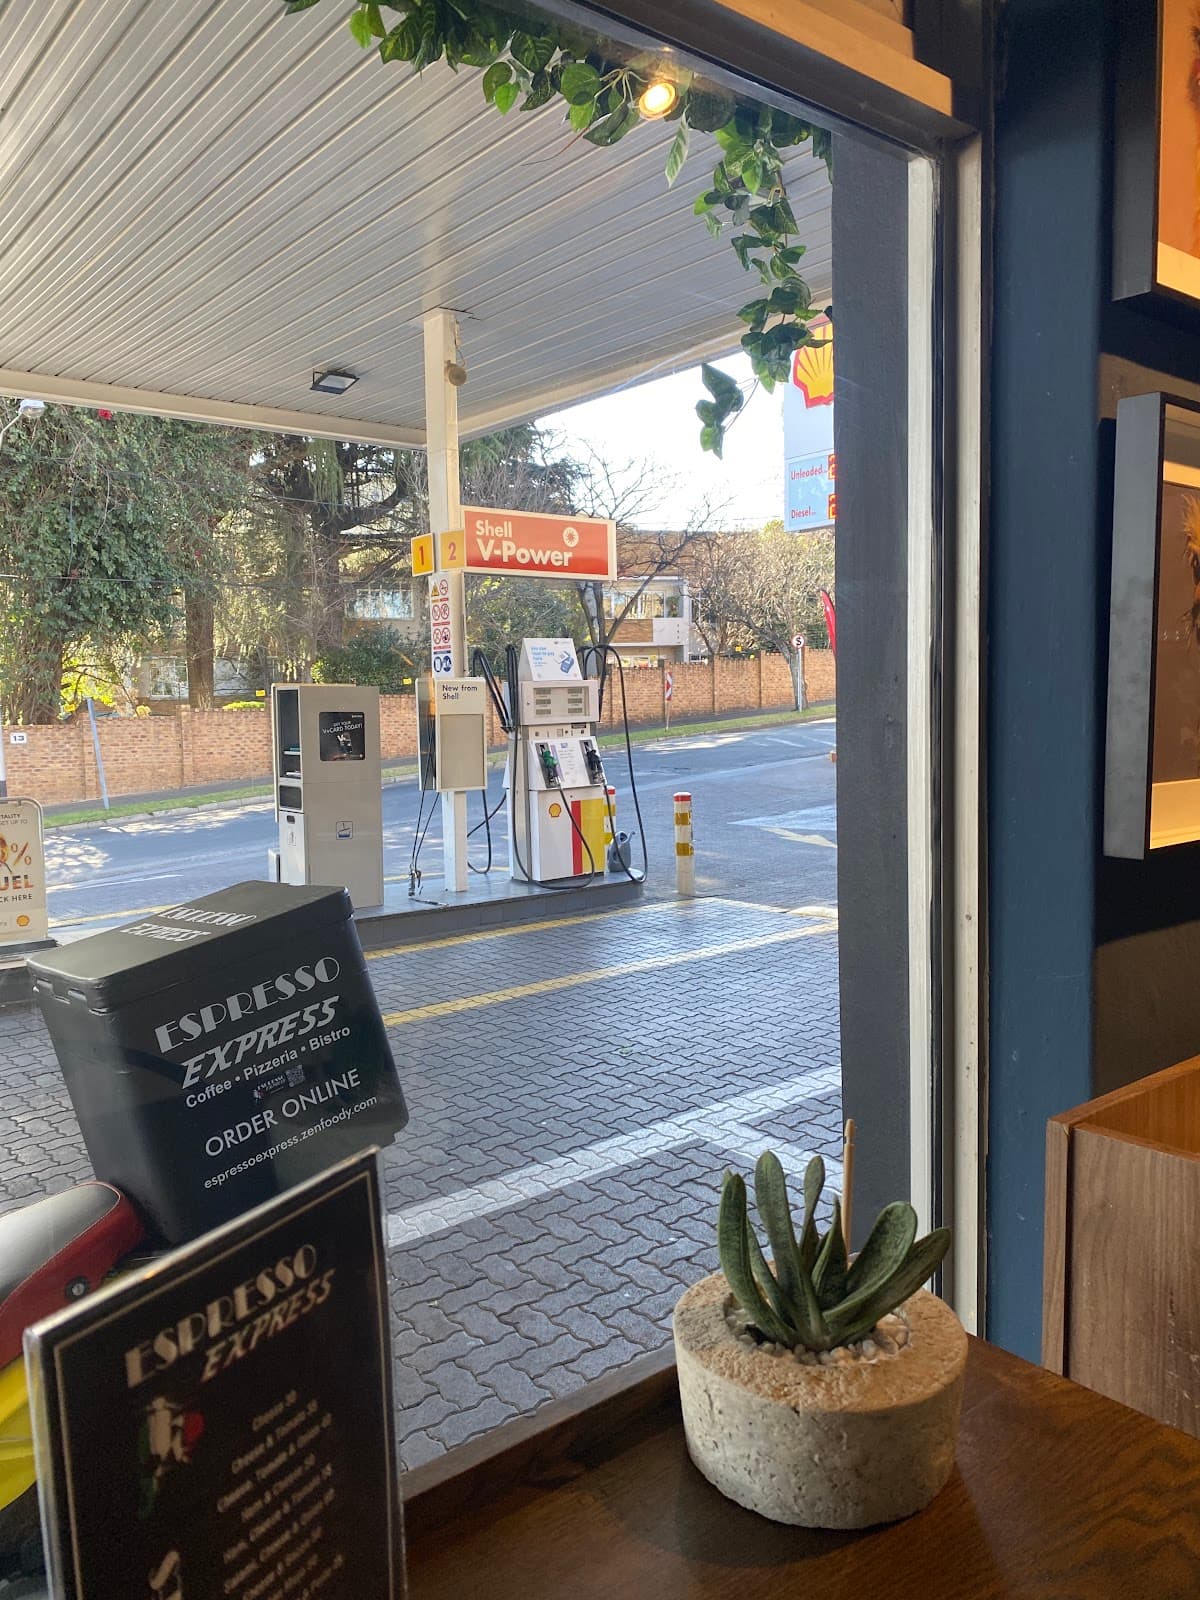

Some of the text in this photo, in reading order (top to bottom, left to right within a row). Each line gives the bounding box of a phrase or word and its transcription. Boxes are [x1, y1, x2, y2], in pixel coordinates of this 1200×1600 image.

[791, 464, 823, 480] Unleaded
[791, 506, 811, 518] Diesel
[476, 519, 512, 538] Shell
[418, 545, 425, 566] 1
[447, 541, 457, 561] 2
[476, 538, 573, 567] V-Power
[461, 684, 478, 692] from
[12, 893, 33, 901] HERE
[154, 956, 340, 1053] ESPRESSO
[182, 995, 340, 1089] EXPRESS
[185, 1078, 232, 1109] Coffee
[243, 1049, 299, 1082] Pizzeria
[308, 1025, 351, 1052] Bistro
[205, 1110, 279, 1157] ORDER
[281, 1068, 361, 1118] ONLINE
[203, 1095, 378, 1190] espressoexpress.zenfoody.com
[124, 1243, 317, 1389] ESPRESSO
[201, 1268, 337, 1383] EXPRESS
